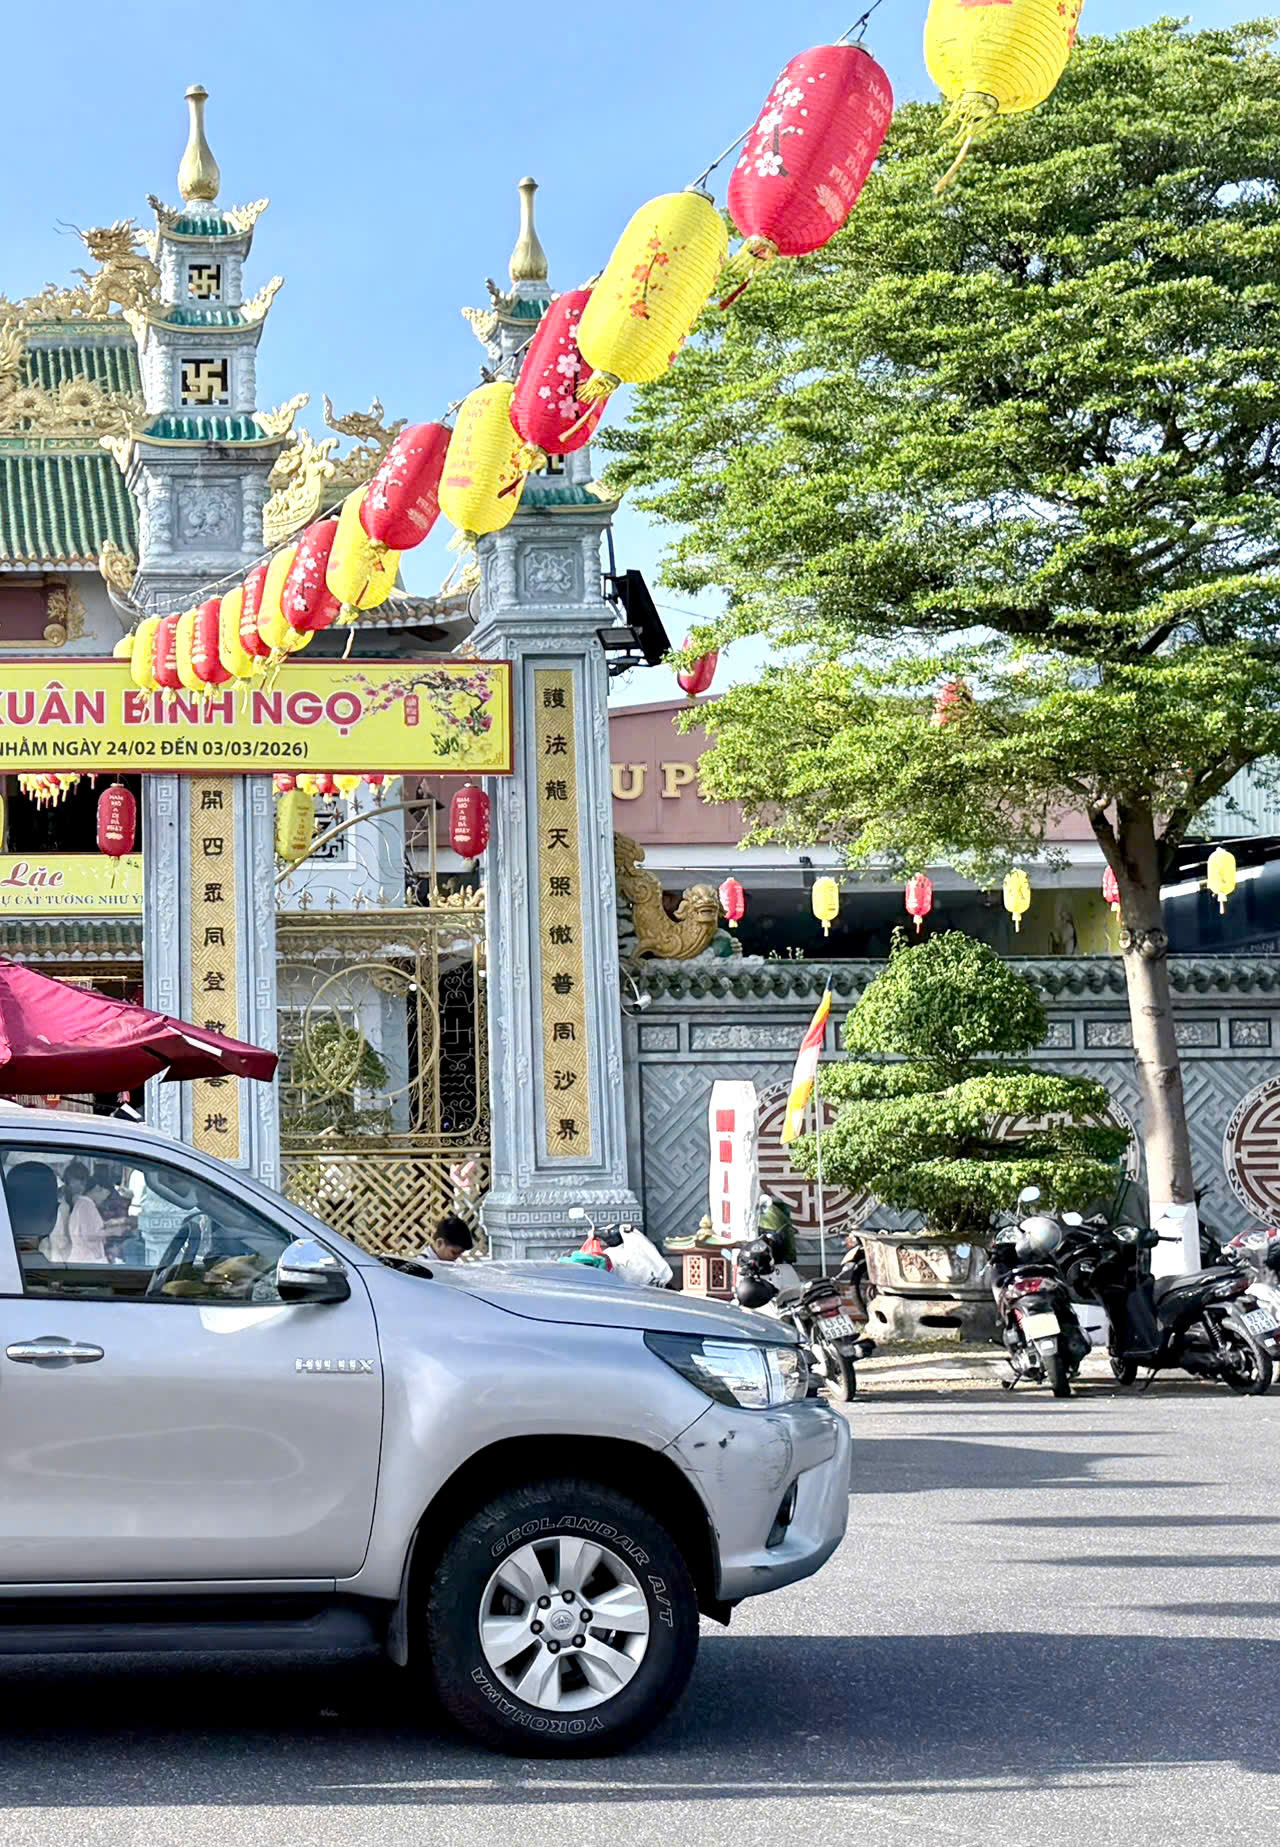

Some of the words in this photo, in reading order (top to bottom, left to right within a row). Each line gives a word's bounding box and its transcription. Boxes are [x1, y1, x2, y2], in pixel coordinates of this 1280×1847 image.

[252, 690, 363, 735] NGỌ
[52, 738, 102, 756] NGÀY
[106, 741, 155, 756] 24/02
[161, 736, 198, 756] ĐẾN
[202, 741, 309, 759] 03/03/2026)
[0, 862, 64, 892] Lặc
[15, 894, 42, 905] CÁT
[45, 893, 94, 905] TƯỜNG
[98, 894, 128, 905] NHƯ
[295, 1358, 375, 1371] HILUX
[490, 1515, 650, 1567] GEOLANDAR
[647, 1573, 674, 1628] A/T
[470, 1665, 605, 1735] YOKOHAMA
